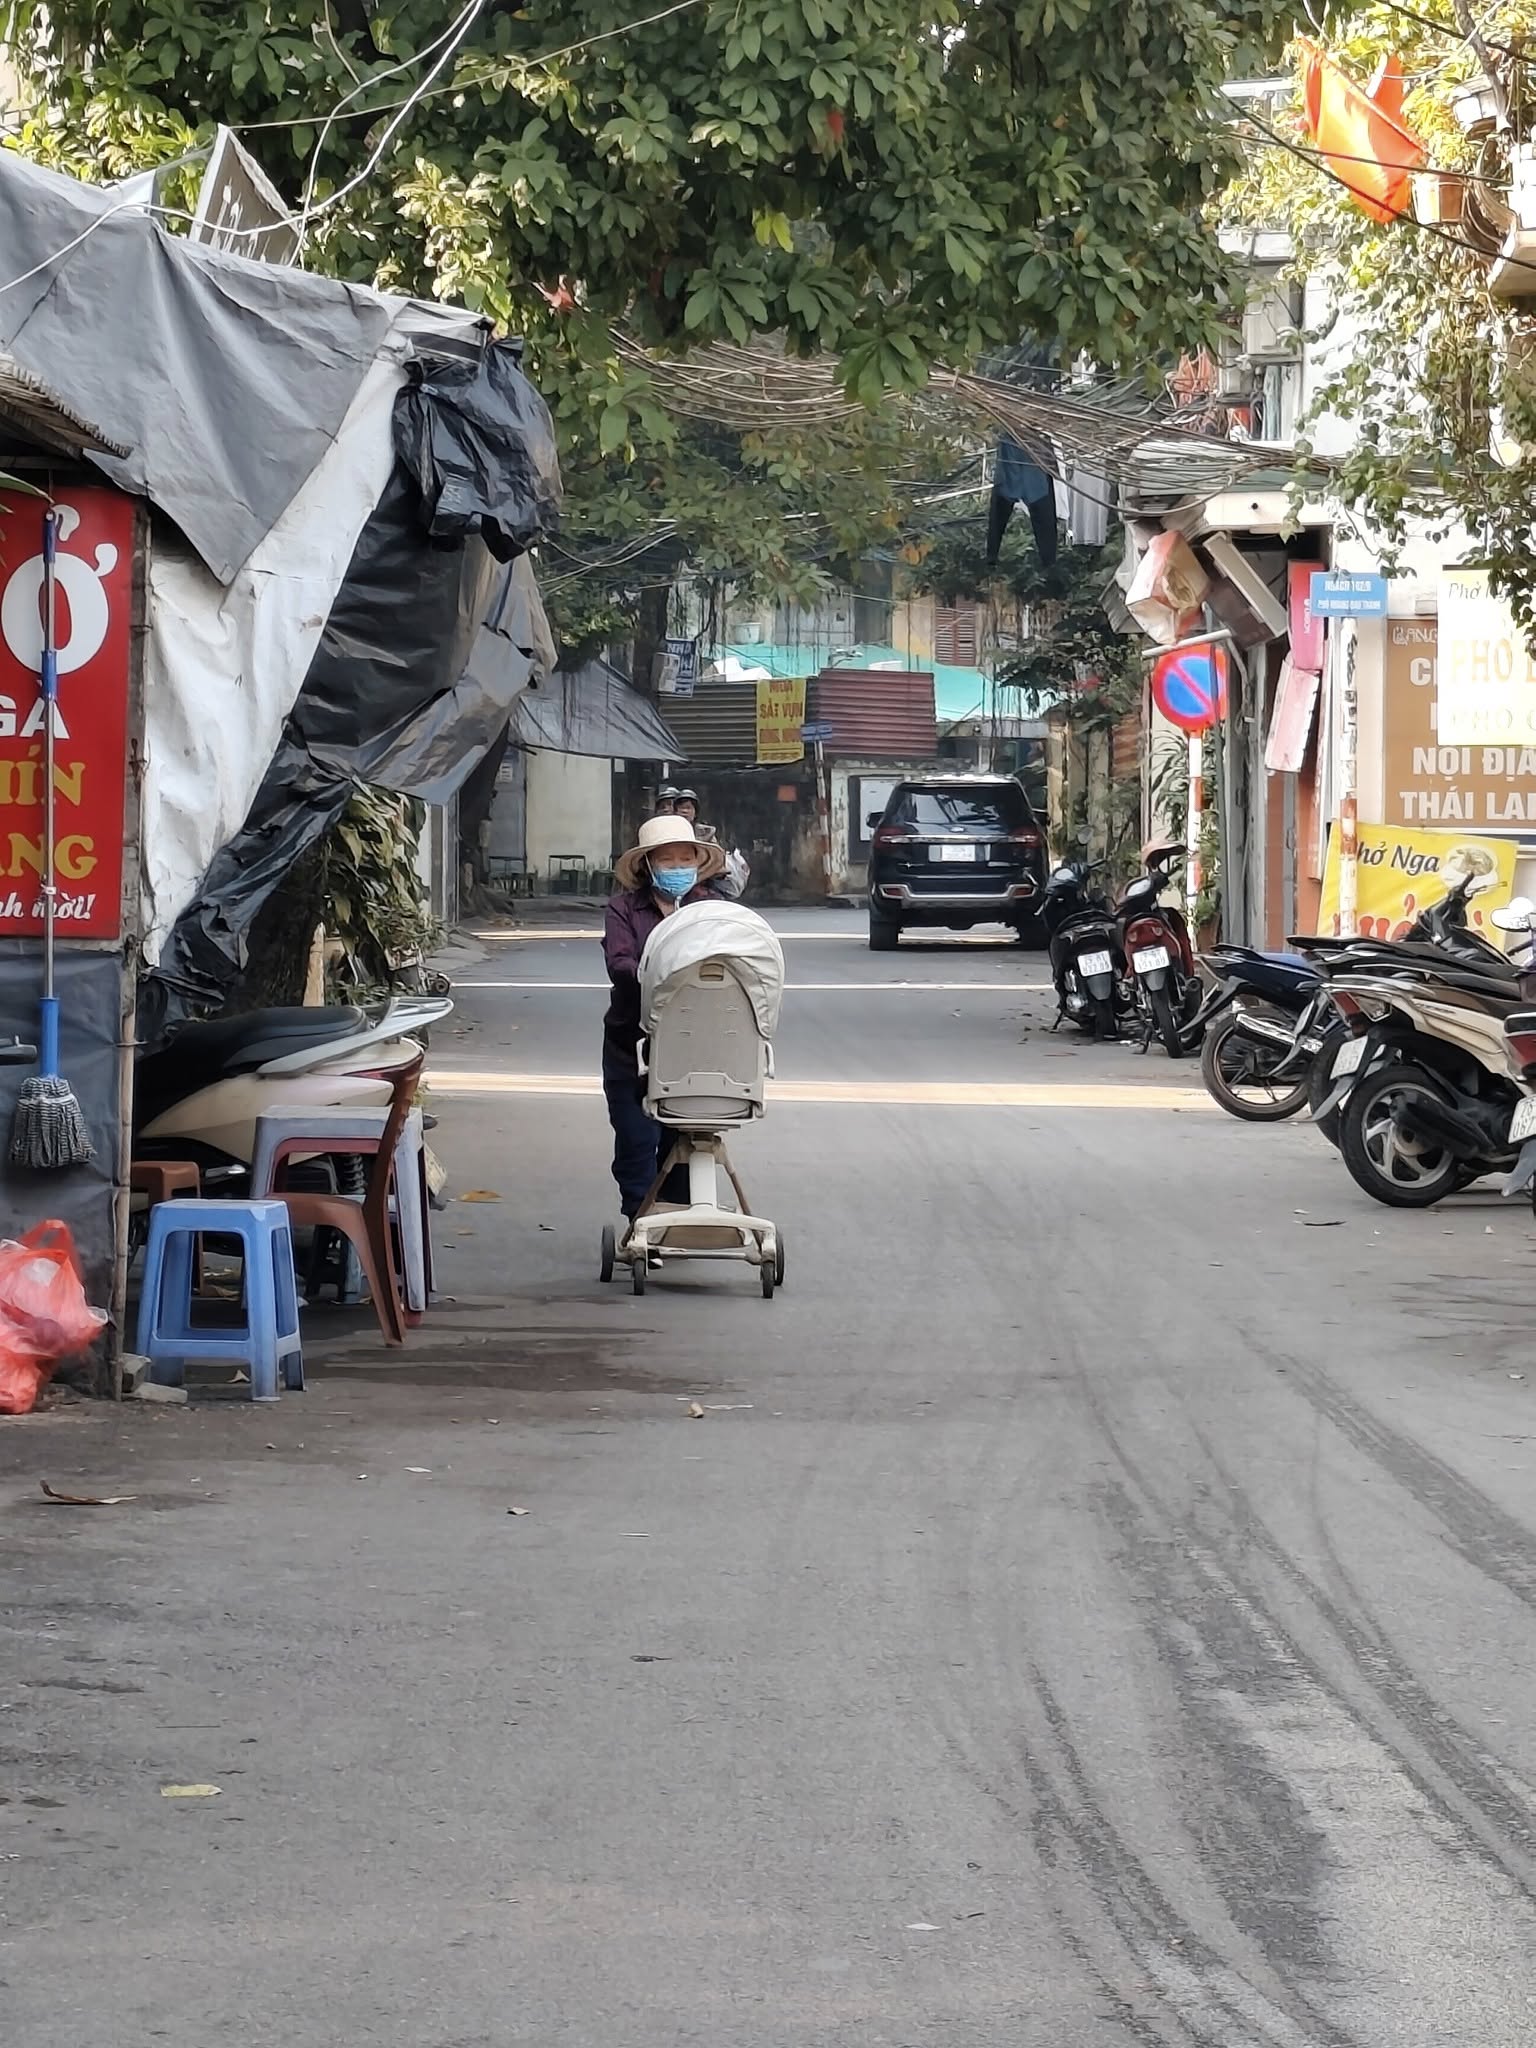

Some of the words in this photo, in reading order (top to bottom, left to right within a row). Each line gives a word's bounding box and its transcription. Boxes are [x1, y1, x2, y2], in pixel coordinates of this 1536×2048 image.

[1400, 786, 1474, 820] THÁI
[0, 832, 98, 880] NG
[1357, 841, 1388, 866] hở
[1391, 845, 1440, 876] Nga
